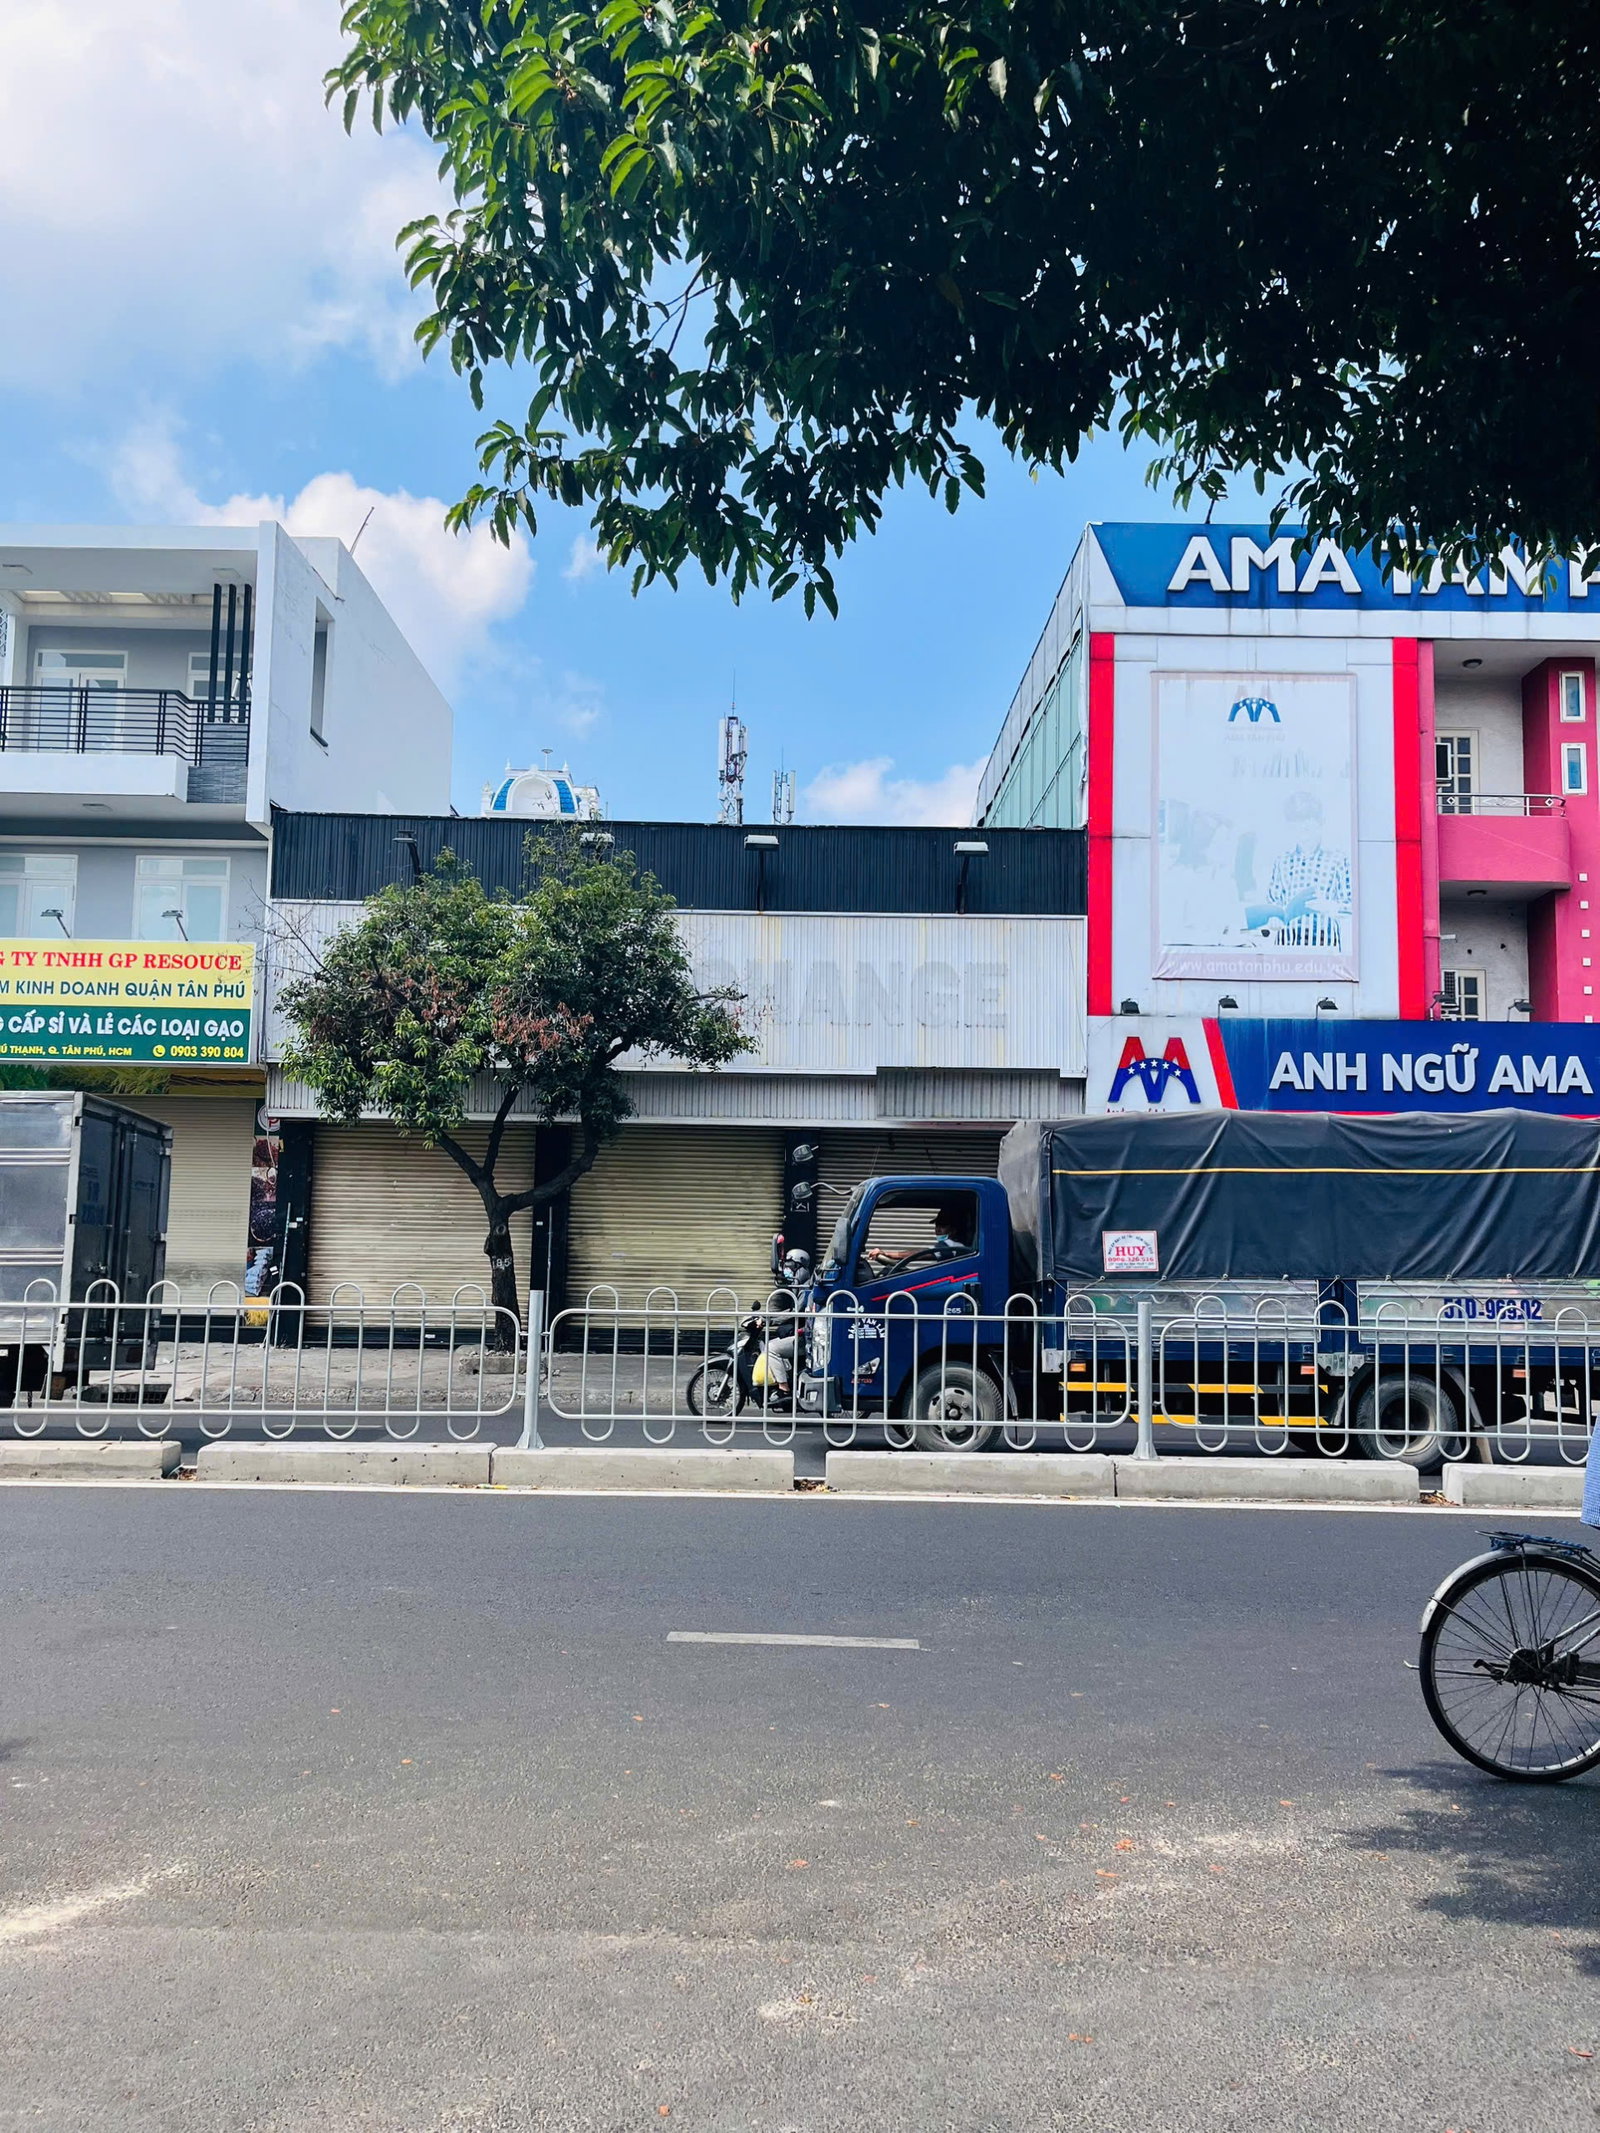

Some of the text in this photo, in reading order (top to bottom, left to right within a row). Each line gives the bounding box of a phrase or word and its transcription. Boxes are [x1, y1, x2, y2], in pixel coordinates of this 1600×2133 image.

[1167, 536, 1362, 593] AMA
[11, 951, 38, 966] TY
[43, 952, 103, 967] TNHH
[109, 953, 138, 968] GP
[143, 953, 242, 970] RESOUCE
[16, 980, 54, 994] KINH
[60, 981, 119, 995] DOANH
[125, 979, 172, 1000] QUẬN
[177, 980, 208, 997] TÂN
[214, 981, 245, 998] PHÚ
[8, 1009, 46, 1033] CẤP
[68, 1013, 92, 1034] VÀ
[96, 1012, 114, 1034] LẺ
[117, 1013, 157, 1035] CÁC
[161, 1019, 200, 1040] LOẠI
[204, 1020, 244, 1041] GẠO
[10, 1045, 46, 1056] THẠNH,
[48, 1046, 59, 1054] Q.
[62, 1044, 82, 1055] TÂN
[83, 1045, 106, 1056] PHÚ,
[108, 1047, 132, 1056] HCM
[170, 1045, 198, 1057] 0903
[200, 1046, 221, 1057] 390
[223, 1047, 244, 1058] 804
[1268, 1042, 1594, 1094] ANH NGỮ AMA
[1115, 1246, 1145, 1256] HUY
